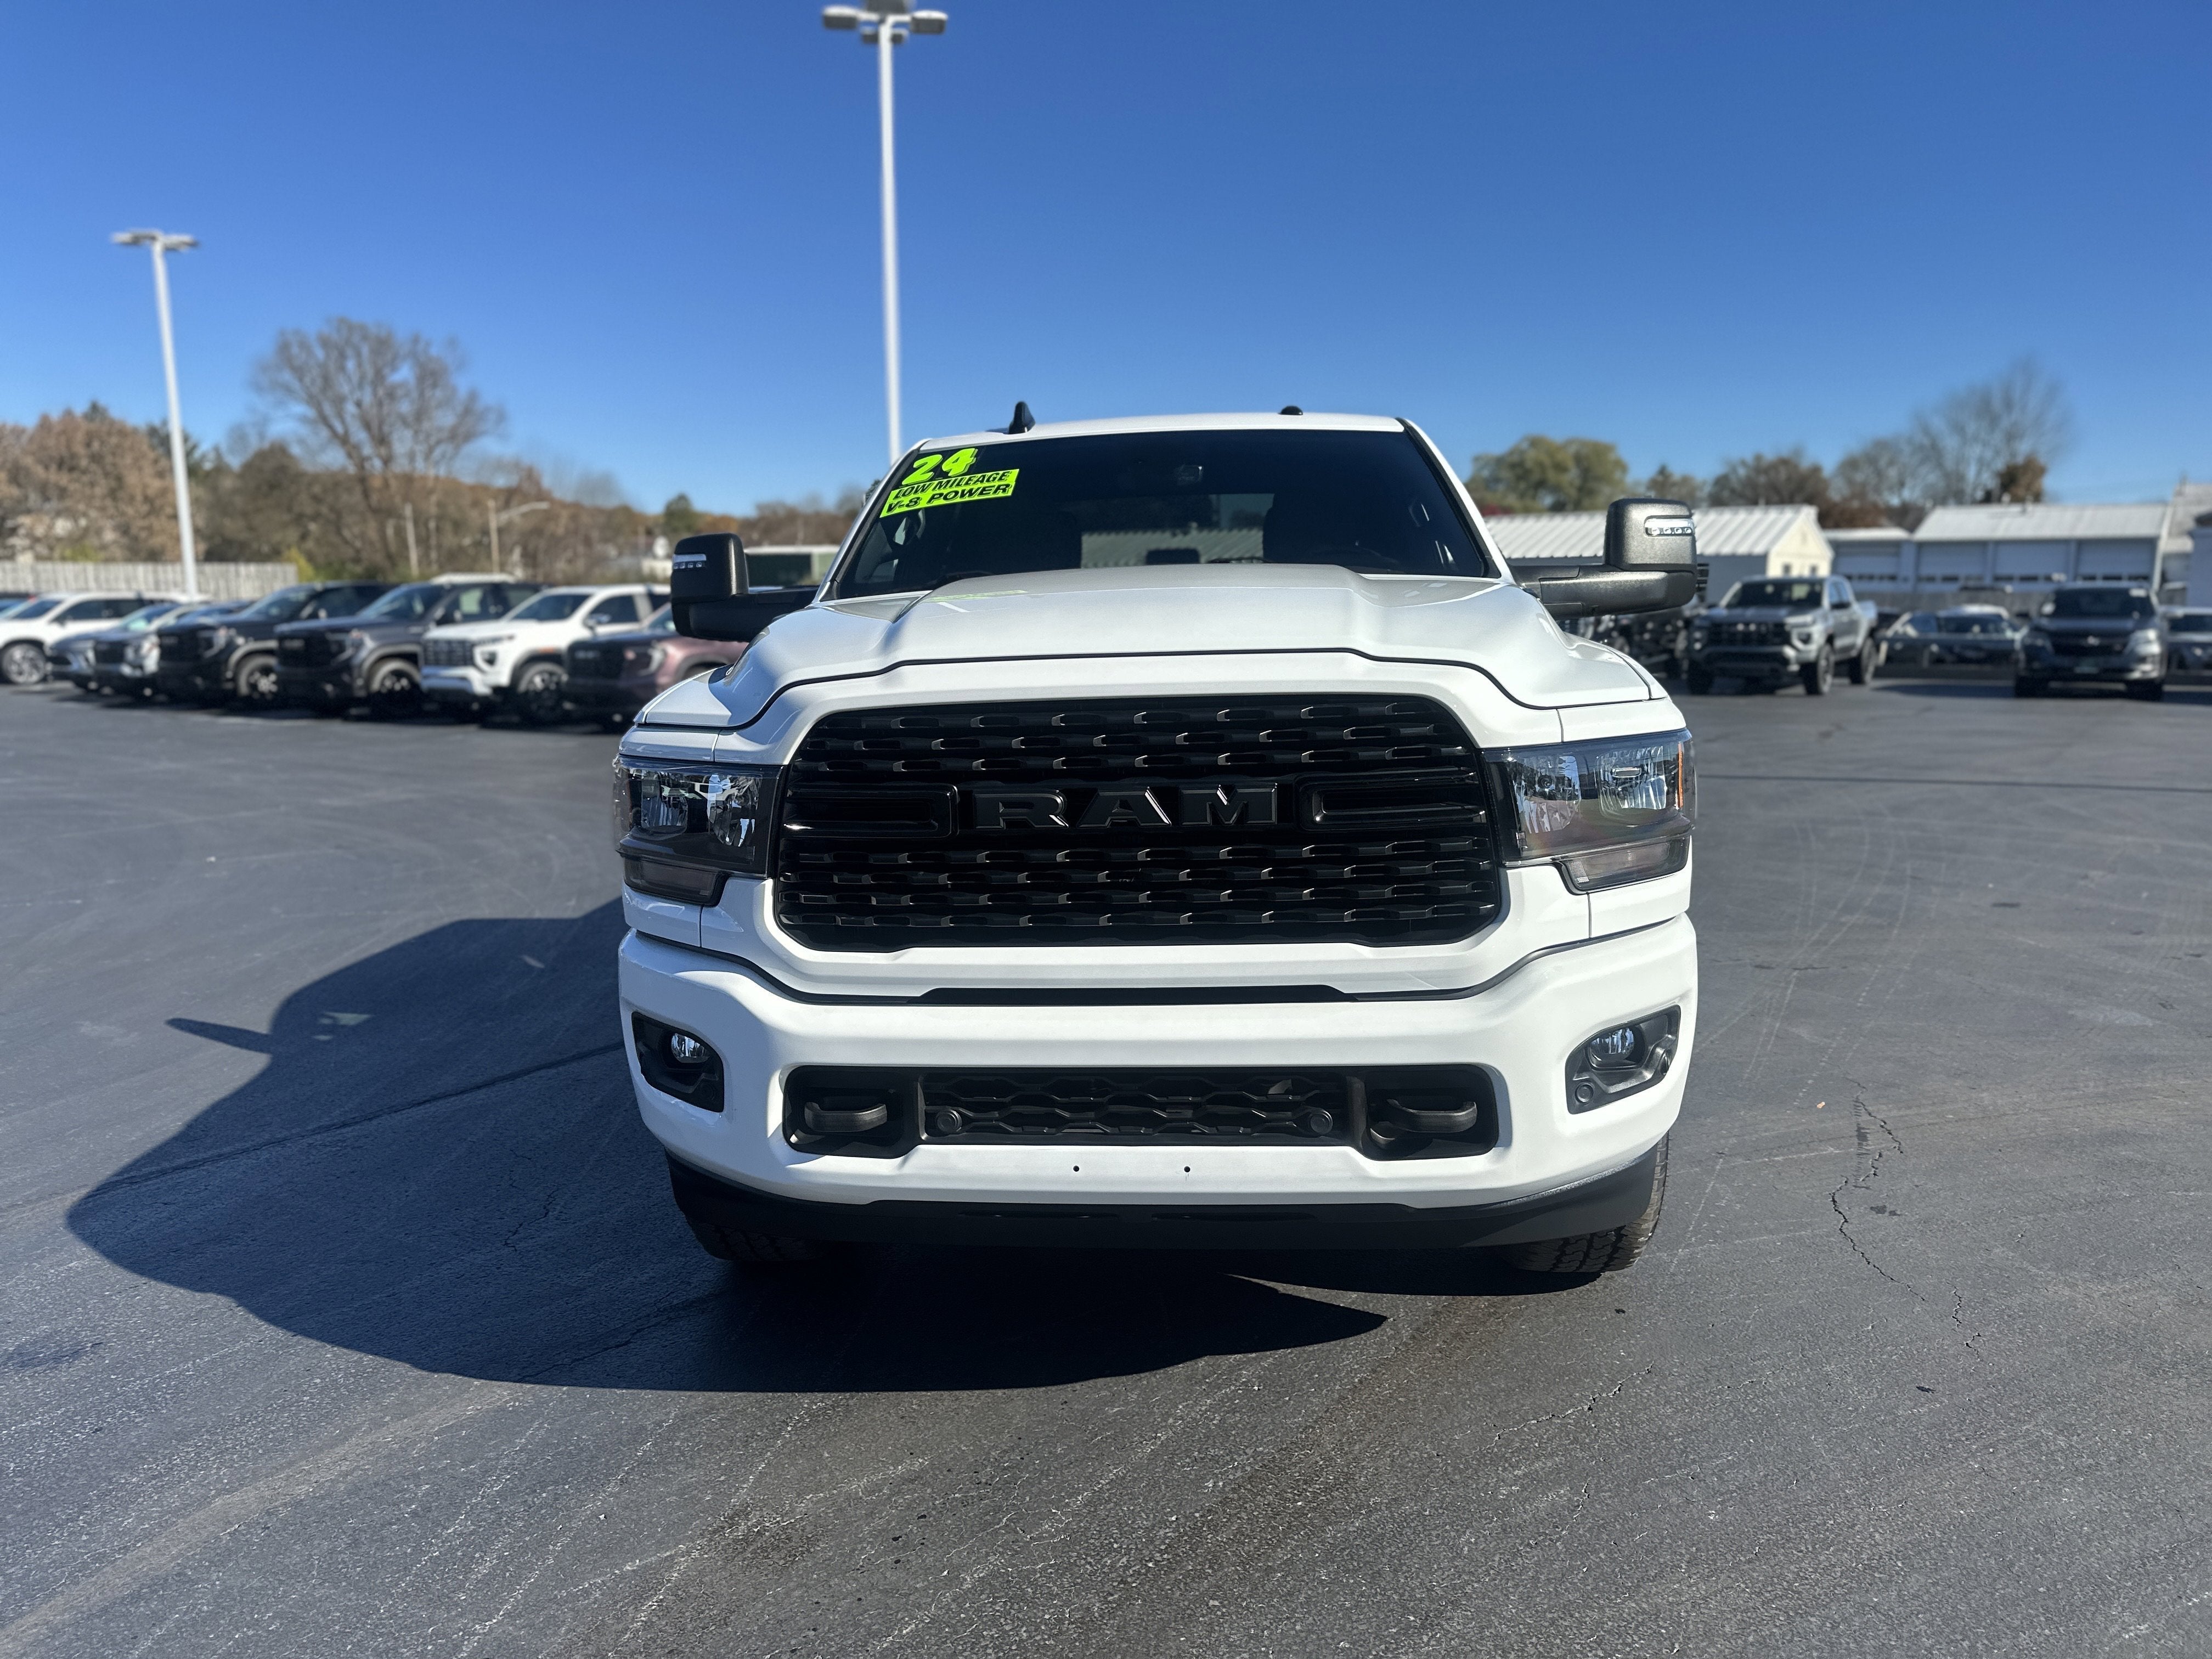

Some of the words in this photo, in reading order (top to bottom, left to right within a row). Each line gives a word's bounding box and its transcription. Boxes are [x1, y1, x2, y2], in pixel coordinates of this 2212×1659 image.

[901, 448, 978, 485] 24
[887, 496, 921, 514] V-8
[926, 484, 1012, 505] POWER
[893, 482, 934, 500] LOW
[933, 471, 1011, 491] MILEAGE
[973, 785, 1278, 829] RAM
